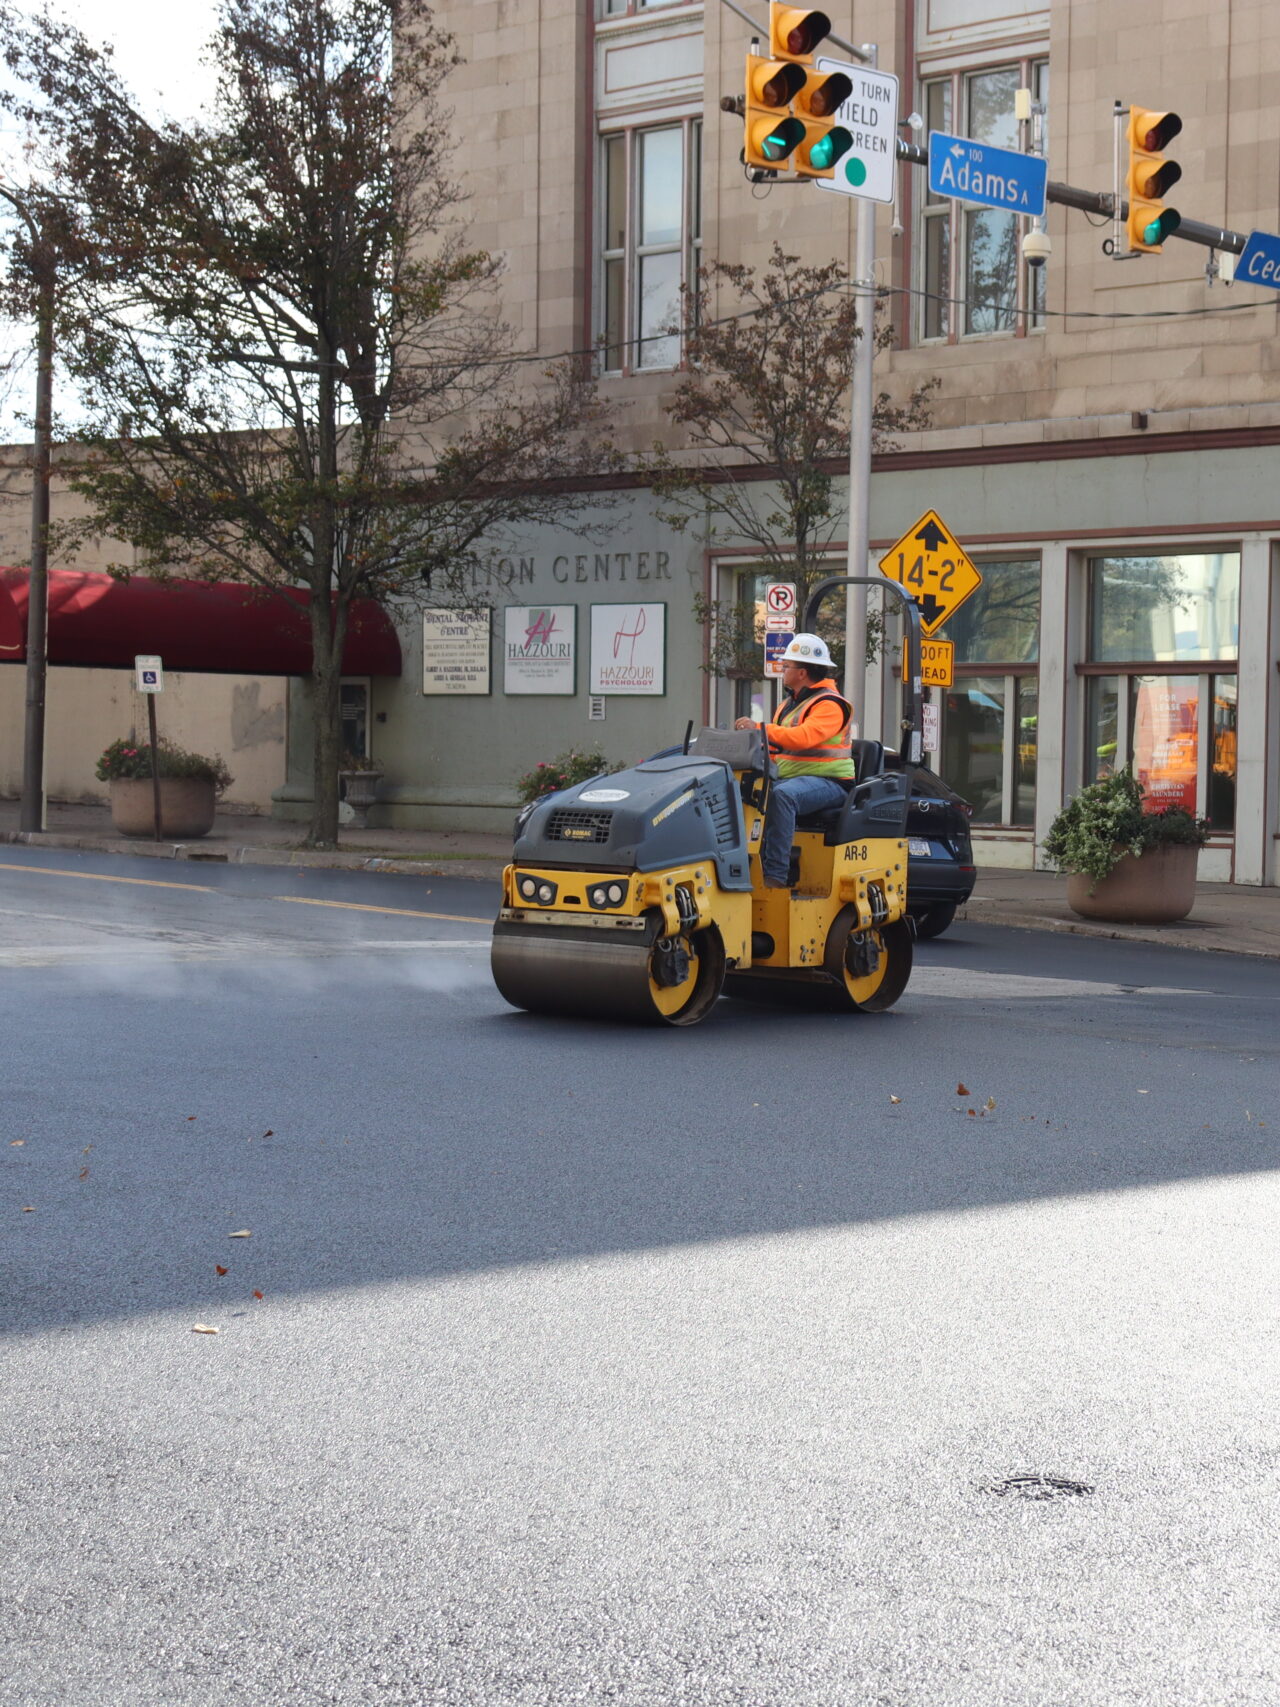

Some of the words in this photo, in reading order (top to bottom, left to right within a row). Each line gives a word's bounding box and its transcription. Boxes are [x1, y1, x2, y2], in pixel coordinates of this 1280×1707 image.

[861, 81, 891, 103] TURN
[840, 101, 878, 127] YIELD
[969, 148, 983, 162] 100
[940, 157, 1018, 202] Adams
[553, 551, 672, 584] CENTER
[508, 643, 571, 658] HAZZOURI
[600, 666, 655, 680] HAZZOURI
[920, 666, 947, 681] HEAD
[1160, 694, 1176, 702] FOR
[844, 844, 868, 861] AR-8
